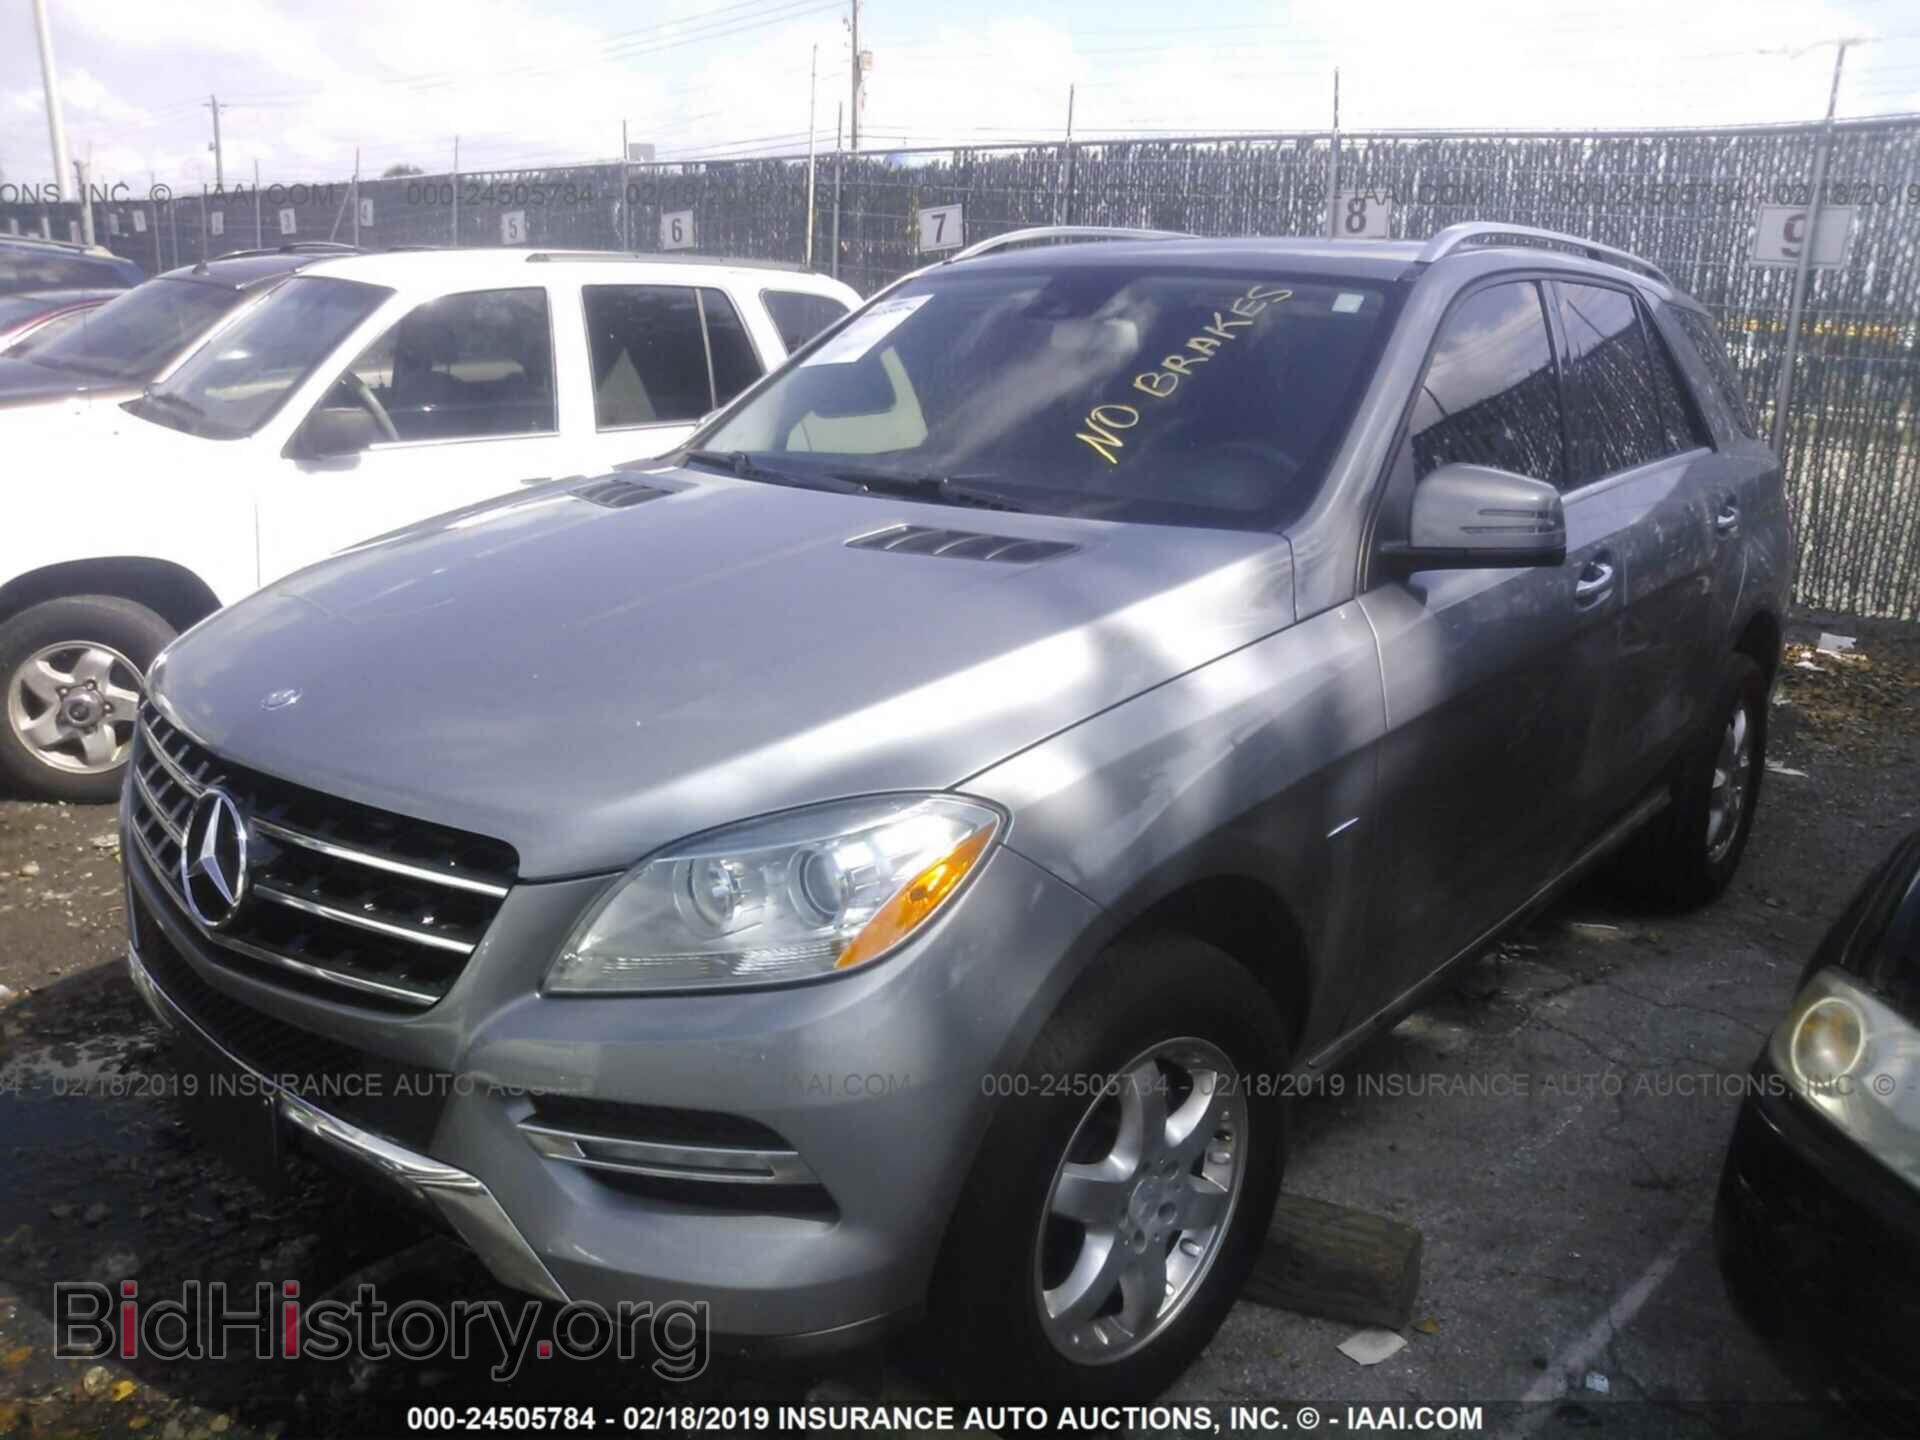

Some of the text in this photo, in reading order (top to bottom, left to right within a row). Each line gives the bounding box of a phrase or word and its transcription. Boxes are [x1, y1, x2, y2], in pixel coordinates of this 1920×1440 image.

[508, 218, 518, 239] 5
[931, 213, 947, 243] 7
[1345, 196, 1367, 234] 8
[671, 218, 683, 243] 6
[1076, 286, 1293, 465] NO BRAKES
